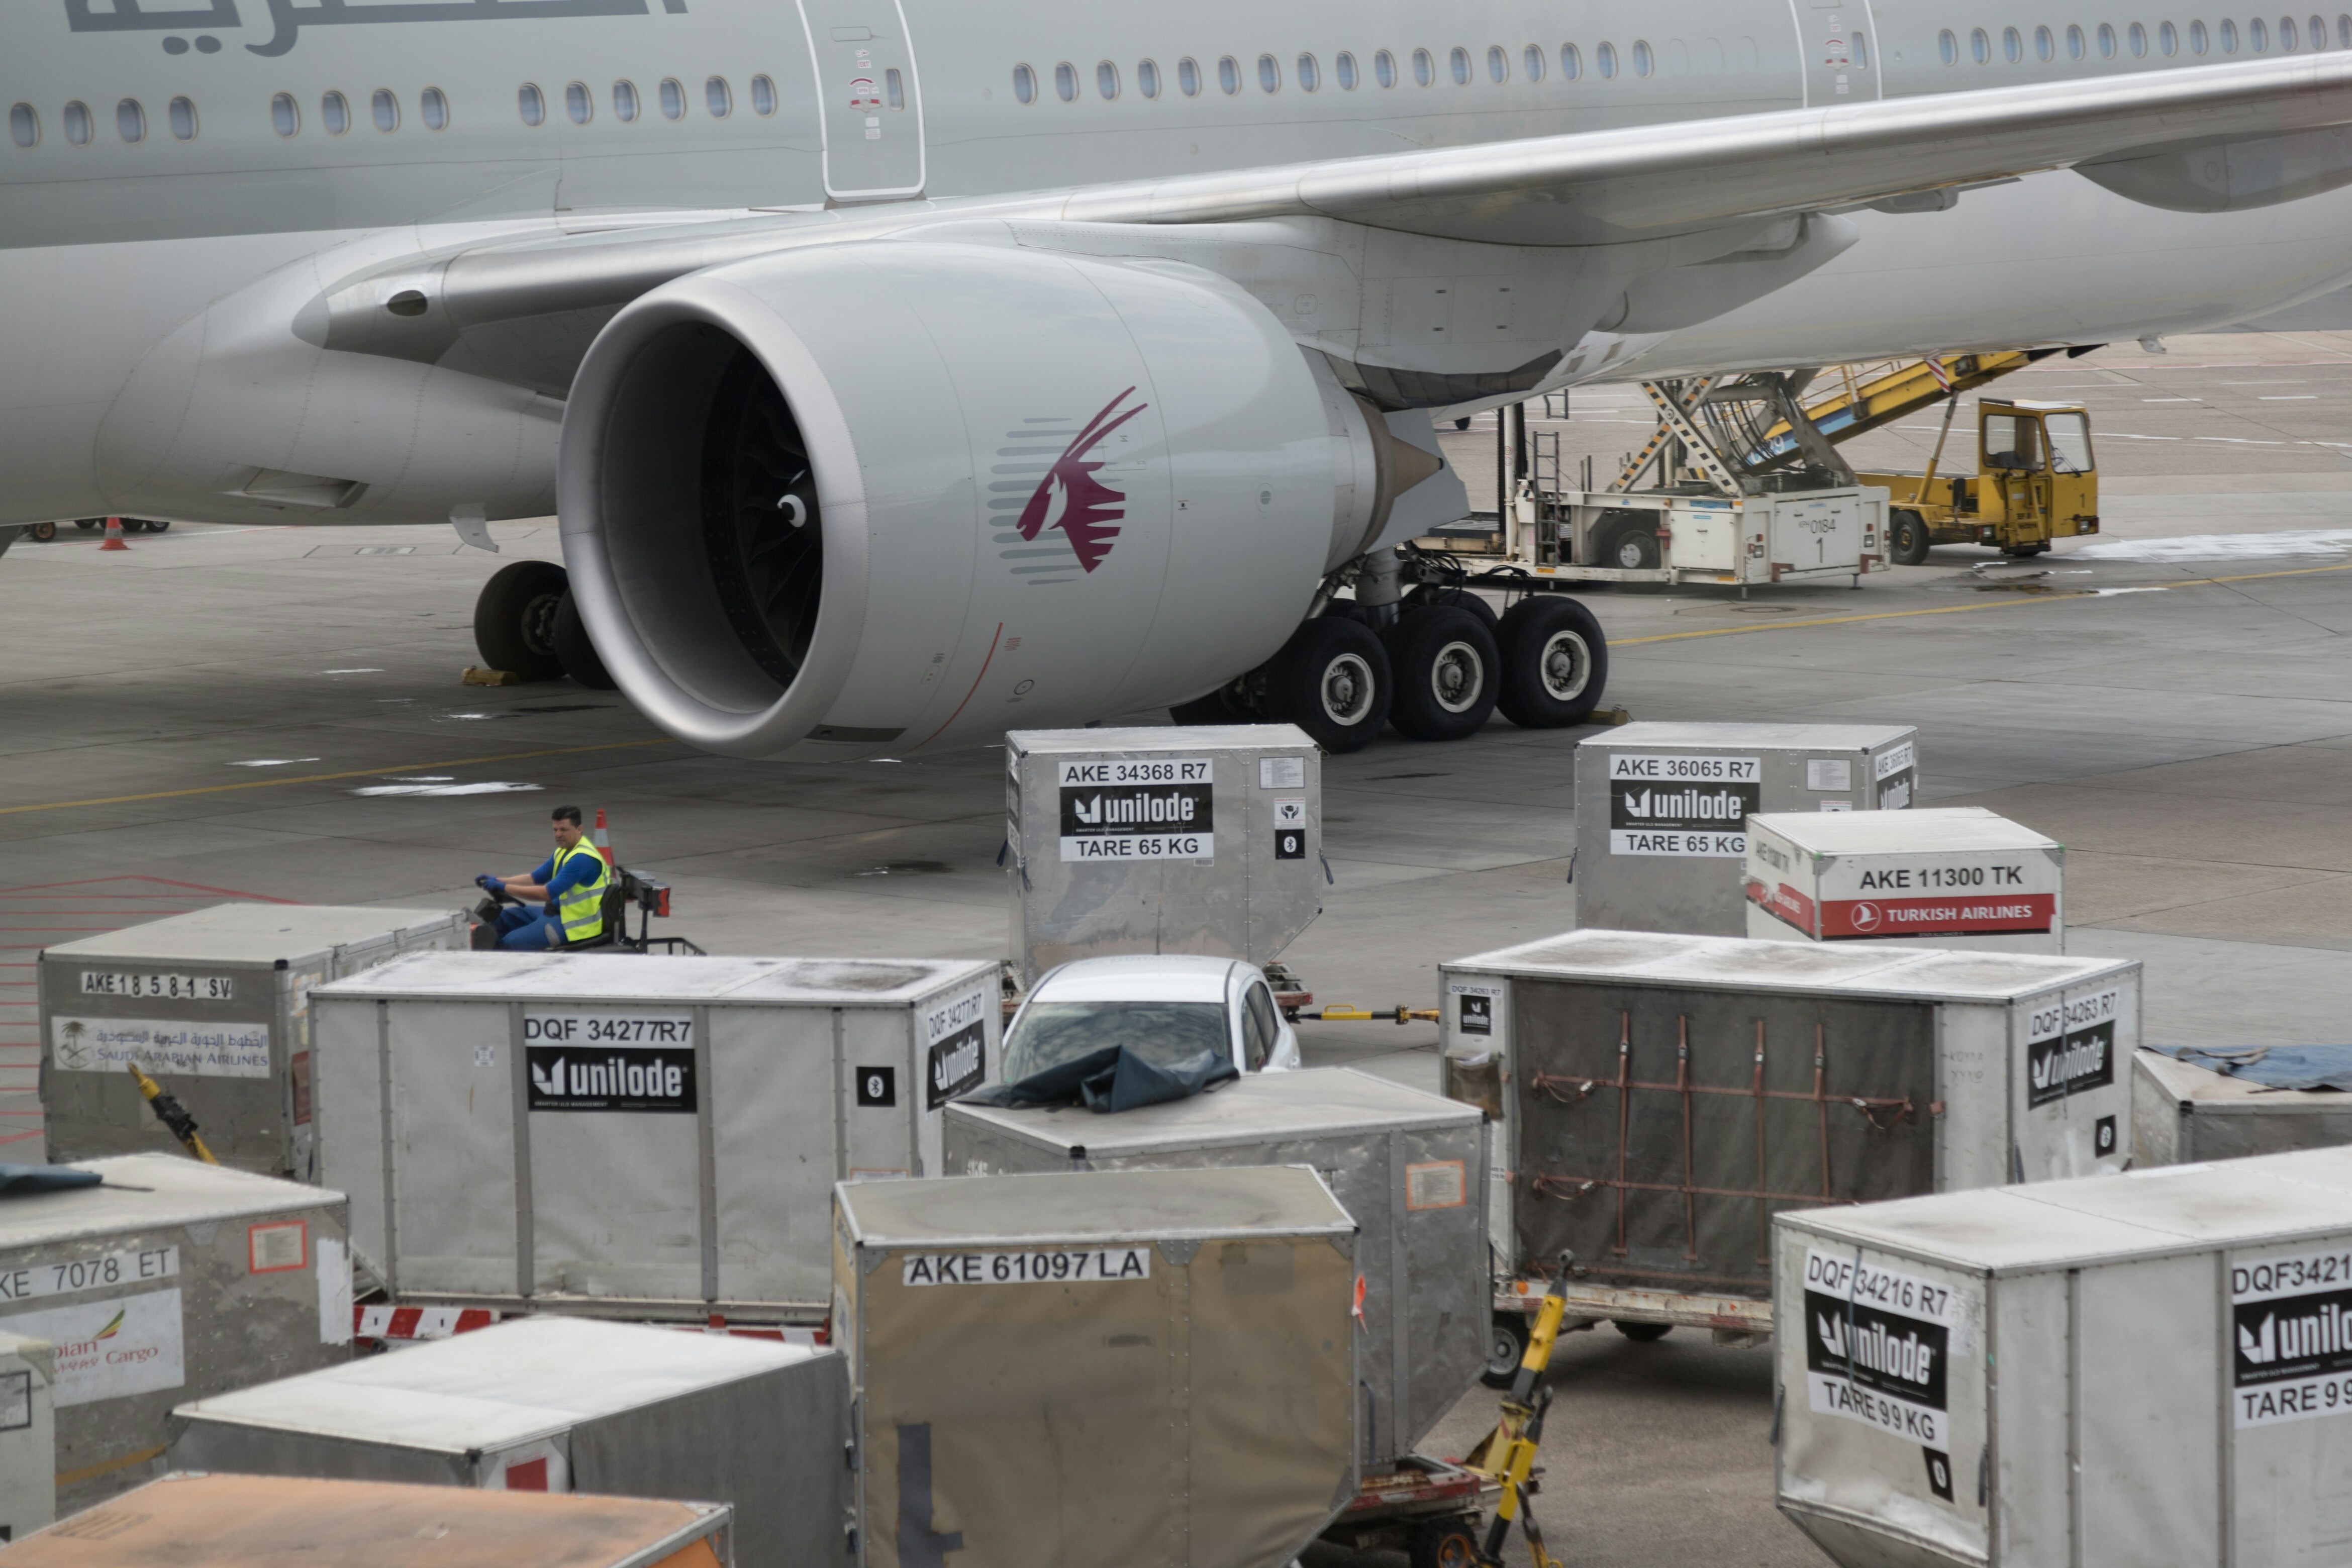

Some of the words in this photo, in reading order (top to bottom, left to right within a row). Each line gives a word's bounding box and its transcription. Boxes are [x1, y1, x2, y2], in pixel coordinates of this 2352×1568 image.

[1816, 537, 1823, 563] 1
[1064, 765, 1110, 782] AKE
[1116, 764, 1173, 780] 34368
[1181, 763, 1207, 779] R7
[1616, 759, 1659, 775] AKE
[1667, 760, 1723, 776] 36065
[1729, 761, 1754, 777] R7
[1105, 792, 1194, 823] unilode
[1654, 789, 1741, 820] unilode
[1076, 840, 1132, 856] TARE
[1138, 839, 1161, 855] 65
[1168, 838, 1199, 854] KG
[1626, 834, 1680, 851] TARE
[1687, 836, 1709, 852] 65
[1715, 836, 1745, 853] KG
[1859, 869, 1911, 889] AKE
[1918, 867, 1984, 887] 11300
[1991, 865, 2023, 885] TK
[1887, 908, 1957, 922] TURKISH
[1961, 905, 2033, 921] AIRLINES
[209, 978, 230, 998] SV
[929, 1011, 945, 1038] DQF
[2032, 1009, 2060, 1036] DQF
[2101, 992, 2116, 1016] R7
[525, 1019, 577, 1041] DQF
[207, 1053, 268, 1066] AIRLINES
[570, 1056, 682, 1097] unilode
[52, 1257, 120, 1291] 7078
[139, 1248, 170, 1278] ET
[909, 1256, 983, 1284] AKE
[992, 1253, 1089, 1282] 61097
[1099, 1250, 1144, 1279] LA
[1809, 1255, 1853, 1290] DQF
[1854, 1268, 1914, 1308] 34216
[1921, 1285, 1948, 1317] R7
[105, 1346, 159, 1365] Cargo
[1844, 1320, 1931, 1386] unilode
[1823, 1381, 1878, 1423] TARE
[1879, 1400, 1902, 1431] 99
[1907, 1408, 1936, 1441] KG
[2242, 1384, 2318, 1421] TARE
